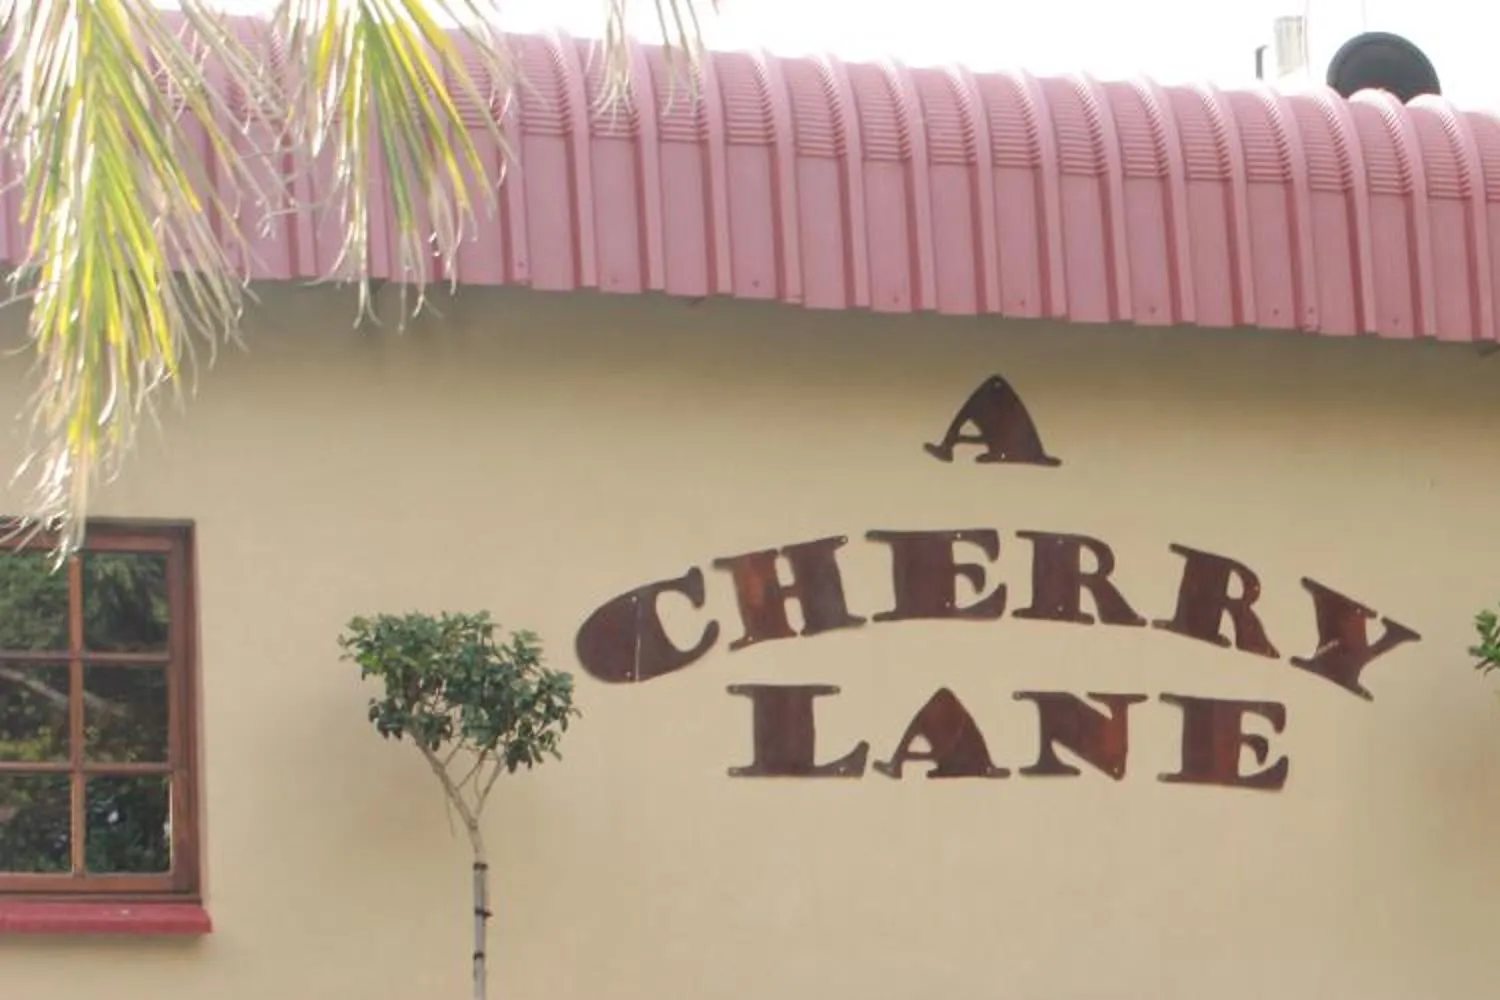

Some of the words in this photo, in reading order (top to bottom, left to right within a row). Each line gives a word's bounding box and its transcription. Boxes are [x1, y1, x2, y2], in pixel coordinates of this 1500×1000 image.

[923, 374, 1062, 467] A
[575, 528, 1422, 701] CHERRY
[726, 683, 1289, 791] LANE
